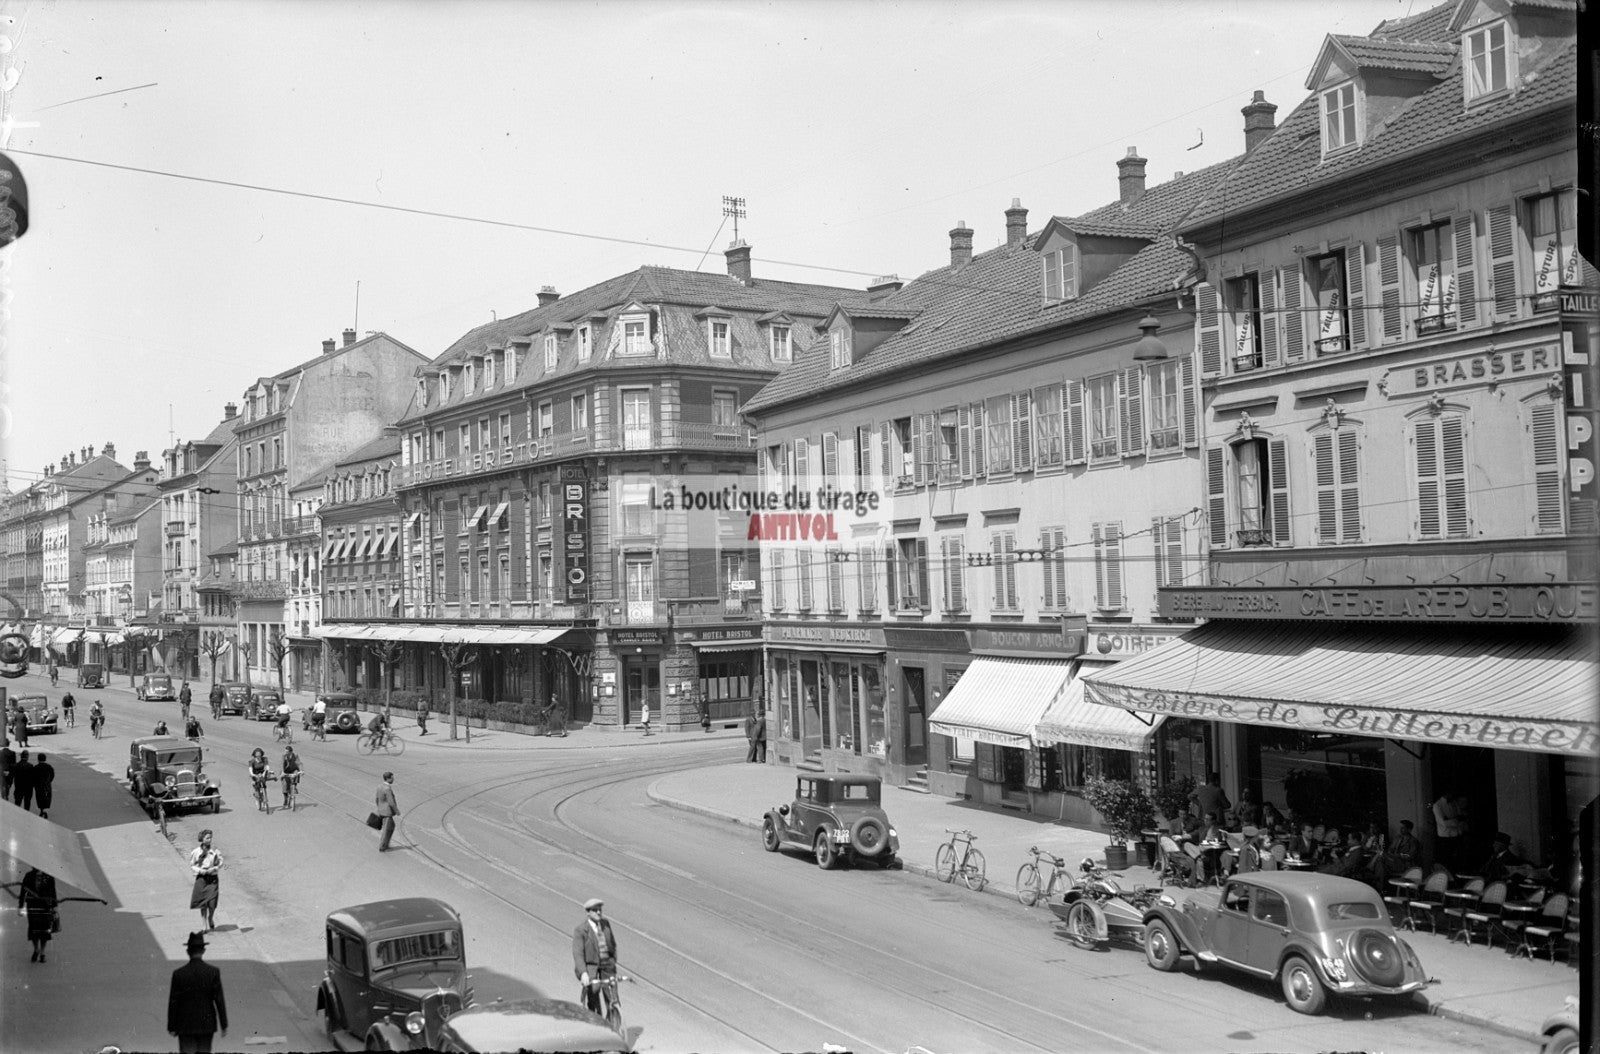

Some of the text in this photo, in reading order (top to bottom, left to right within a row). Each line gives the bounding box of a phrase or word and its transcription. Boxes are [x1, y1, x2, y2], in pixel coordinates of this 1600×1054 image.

[1538, 240, 1557, 287] COUTURE
[1565, 243, 1578, 281] SPOR
[1421, 265, 1440, 313] TAILLEURS
[1443, 270, 1456, 311] MANTE
[1560, 294, 1599, 311] TAILLE
[1237, 313, 1250, 352] TAILLEUR
[1322, 292, 1340, 334] TAILLEUR
[1414, 345, 1559, 389] BRASSERI
[1562, 331, 1595, 492] LIPP
[413, 439, 553, 480] HOTEL BRISTOL
[561, 467, 586, 479] HOTEL
[566, 484, 586, 599] BRISTOL
[1360, 600, 1384, 617] DE
[1388, 598, 1413, 617] LA
[1413, 587, 1598, 619] REPUBLIQUE
[702, 630, 752, 640] HOTEL BRISTOL
[782, 627, 823, 641] PHARMACIE
[1035, 633, 1076, 648] ARNOLD
[1256, 702, 1302, 725] de
